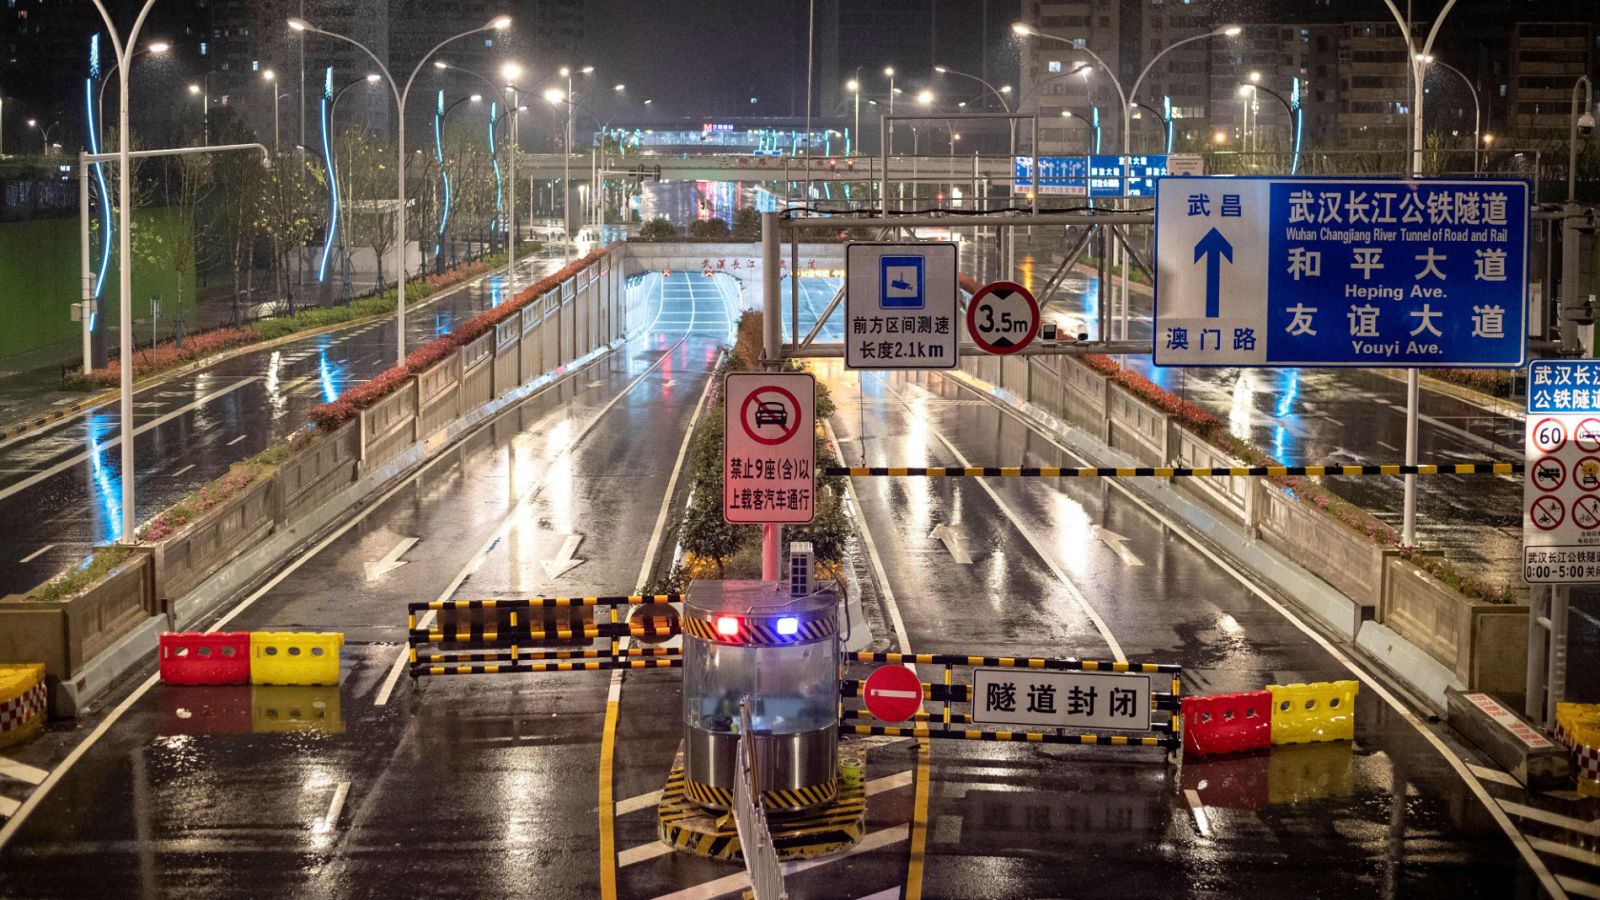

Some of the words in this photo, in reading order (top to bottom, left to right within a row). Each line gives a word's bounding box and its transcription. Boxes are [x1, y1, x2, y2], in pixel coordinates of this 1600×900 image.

[1187, 193, 1242, 218] 武昌
[1288, 189, 1508, 225] 武汉长江公铁隧道
[1286, 227, 1317, 241] Wuhan
[1320, 227, 1371, 244] Changjiang
[1373, 228, 1397, 241] River
[1401, 228, 1431, 241] Tunnel
[1432, 228, 1444, 241] of
[1445, 228, 1468, 241] Road
[1470, 228, 1488, 242] and
[1490, 229, 1508, 242] Rail
[1286, 247, 1508, 281] 和平大道
[1345, 284, 1404, 301] Heping
[1410, 284, 1447, 298] Ave.
[853, 315, 950, 335] 前方区间测速
[978, 304, 1028, 333] 3.5m
[1285, 302, 1505, 339] 友谊大道
[859, 341, 944, 359] 长度2.1km
[1166, 327, 1257, 351] 澳门路
[1352, 340, 1400, 357] Youyi
[1406, 341, 1444, 355] Ave.
[1540, 427, 1561, 444] 60
[730, 457, 810, 480] 禁止9座(含)以
[729, 488, 810, 511] 上载客汽车通行
[986, 682, 1137, 718] 隧道封闭
